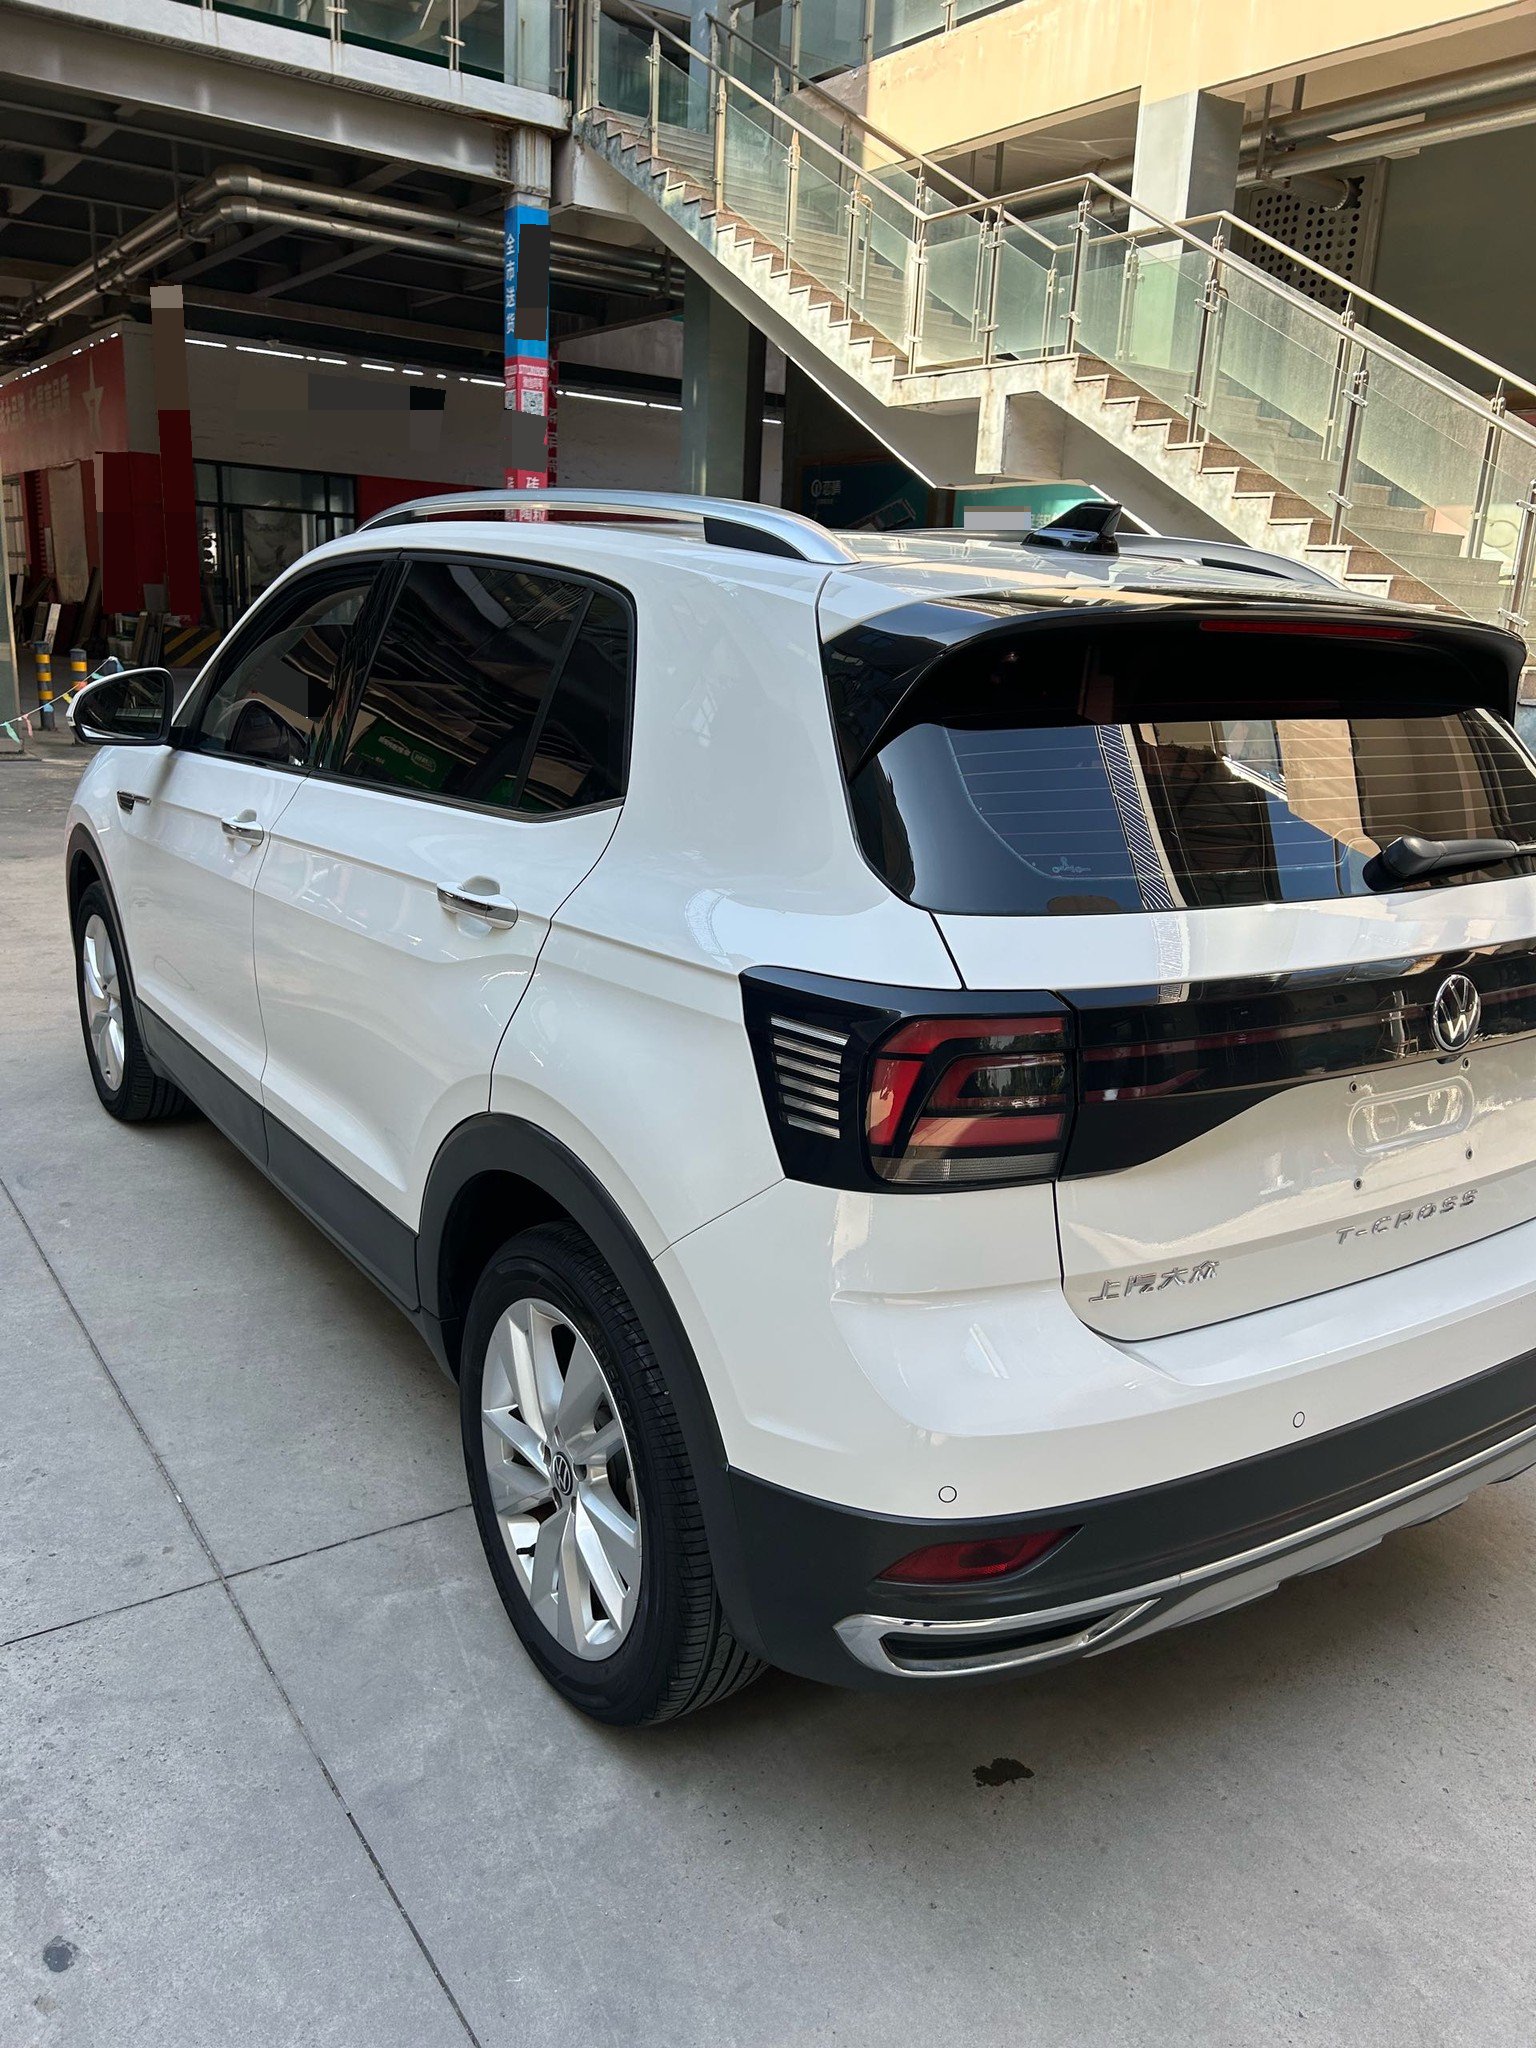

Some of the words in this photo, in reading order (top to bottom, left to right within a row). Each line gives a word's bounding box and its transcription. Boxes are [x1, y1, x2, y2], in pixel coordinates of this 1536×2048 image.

[1335, 1188, 1480, 1246] T-CROSS
[1088, 1259, 1221, 1304] 上汽大众
